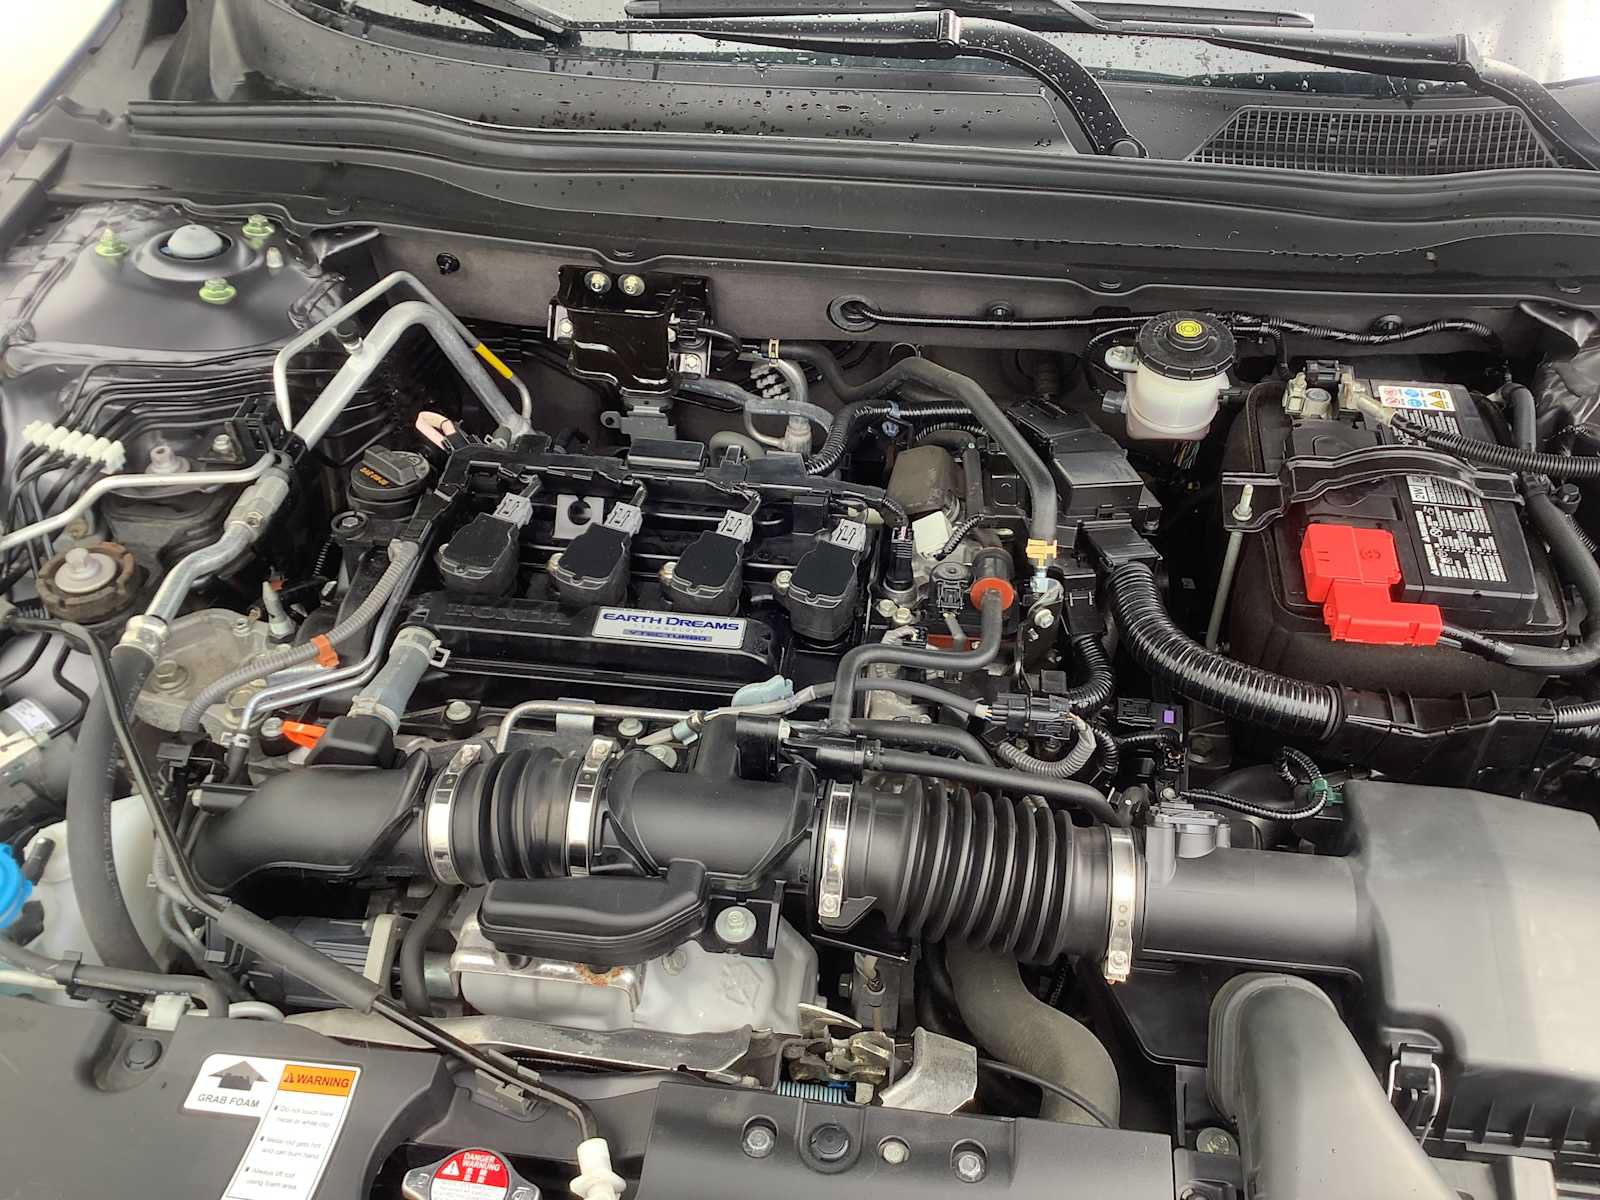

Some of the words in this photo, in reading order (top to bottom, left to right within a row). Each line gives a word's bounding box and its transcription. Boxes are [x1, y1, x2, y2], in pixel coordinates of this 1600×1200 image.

[603, 612, 662, 625] EARTH
[666, 616, 740, 631] DREAMS
[297, 1074, 349, 1089] WARNING
[198, 1093, 227, 1105] GRAB
[229, 1096, 260, 1108] FOAM
[464, 1152, 495, 1163] DANGER
